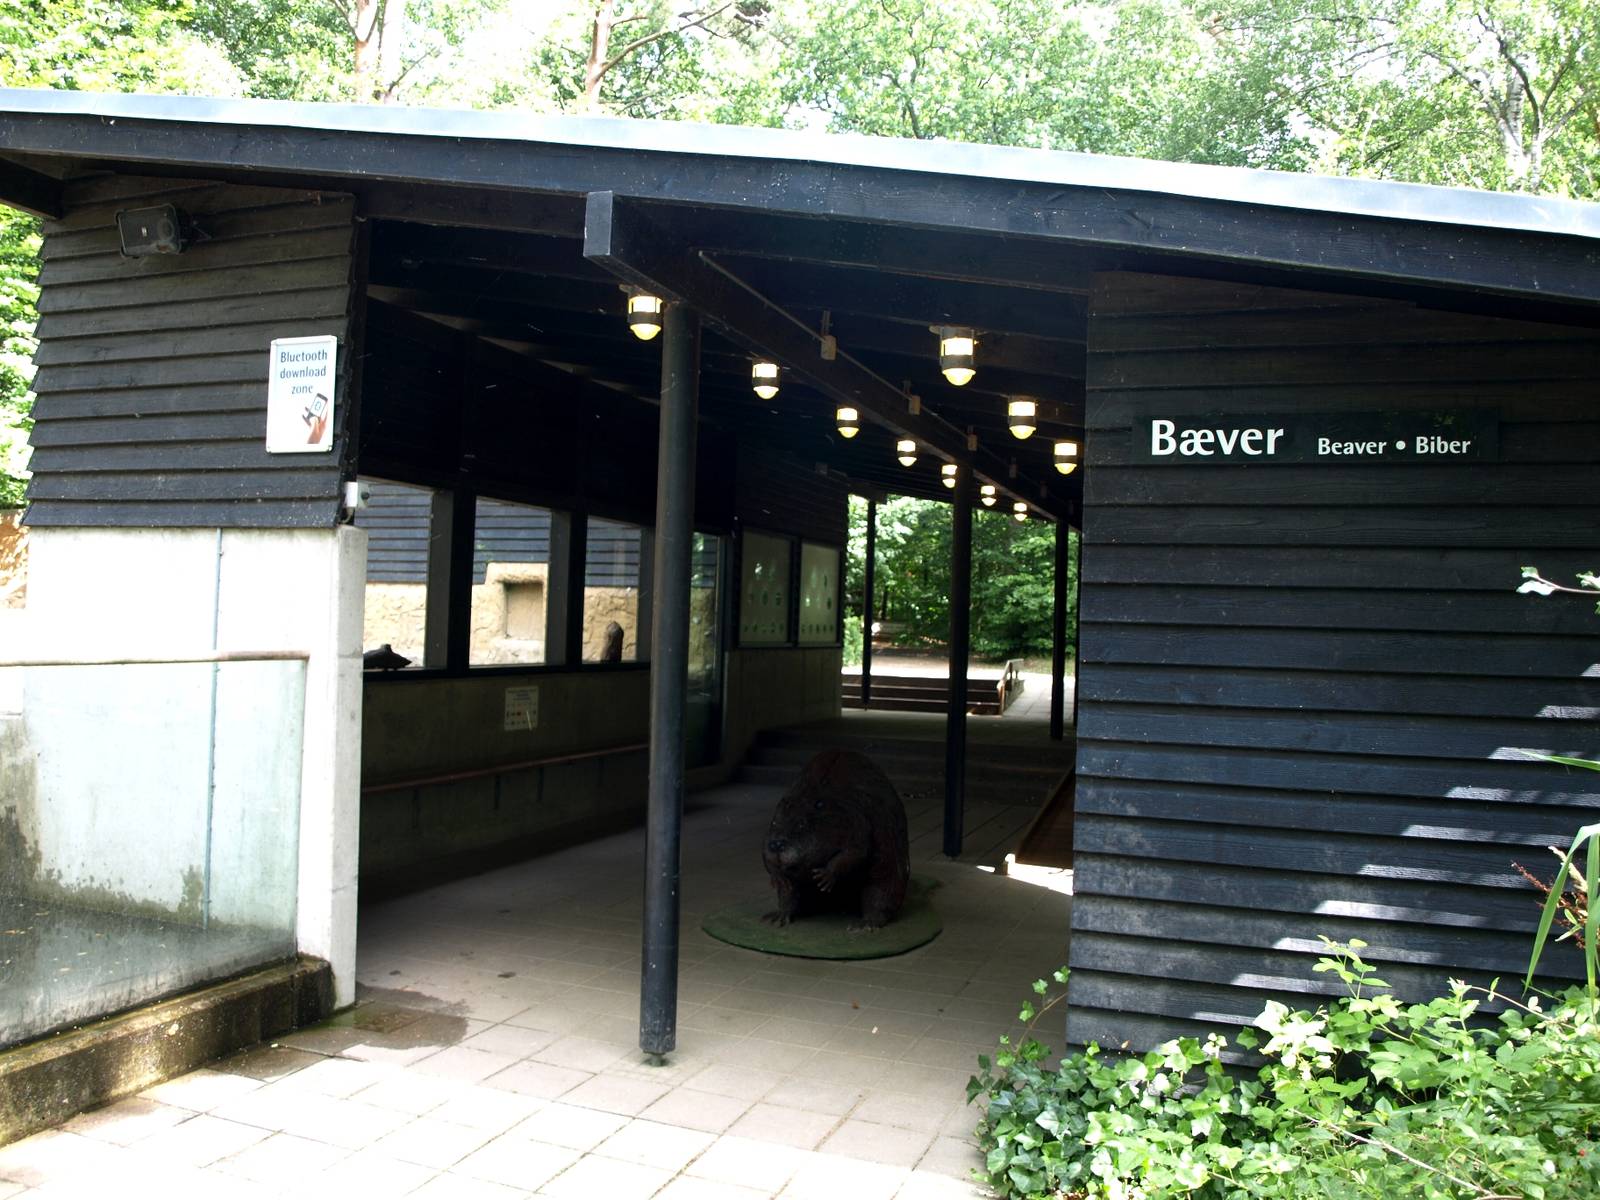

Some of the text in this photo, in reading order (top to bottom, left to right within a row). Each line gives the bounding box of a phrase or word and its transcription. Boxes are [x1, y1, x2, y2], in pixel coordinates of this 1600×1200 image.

[280, 349, 328, 363] Bluetooth
[280, 366, 327, 379] download
[291, 384, 313, 395] zone
[1151, 419, 1284, 456] Bæver
[1317, 436, 1471, 455] Beaver Biber
